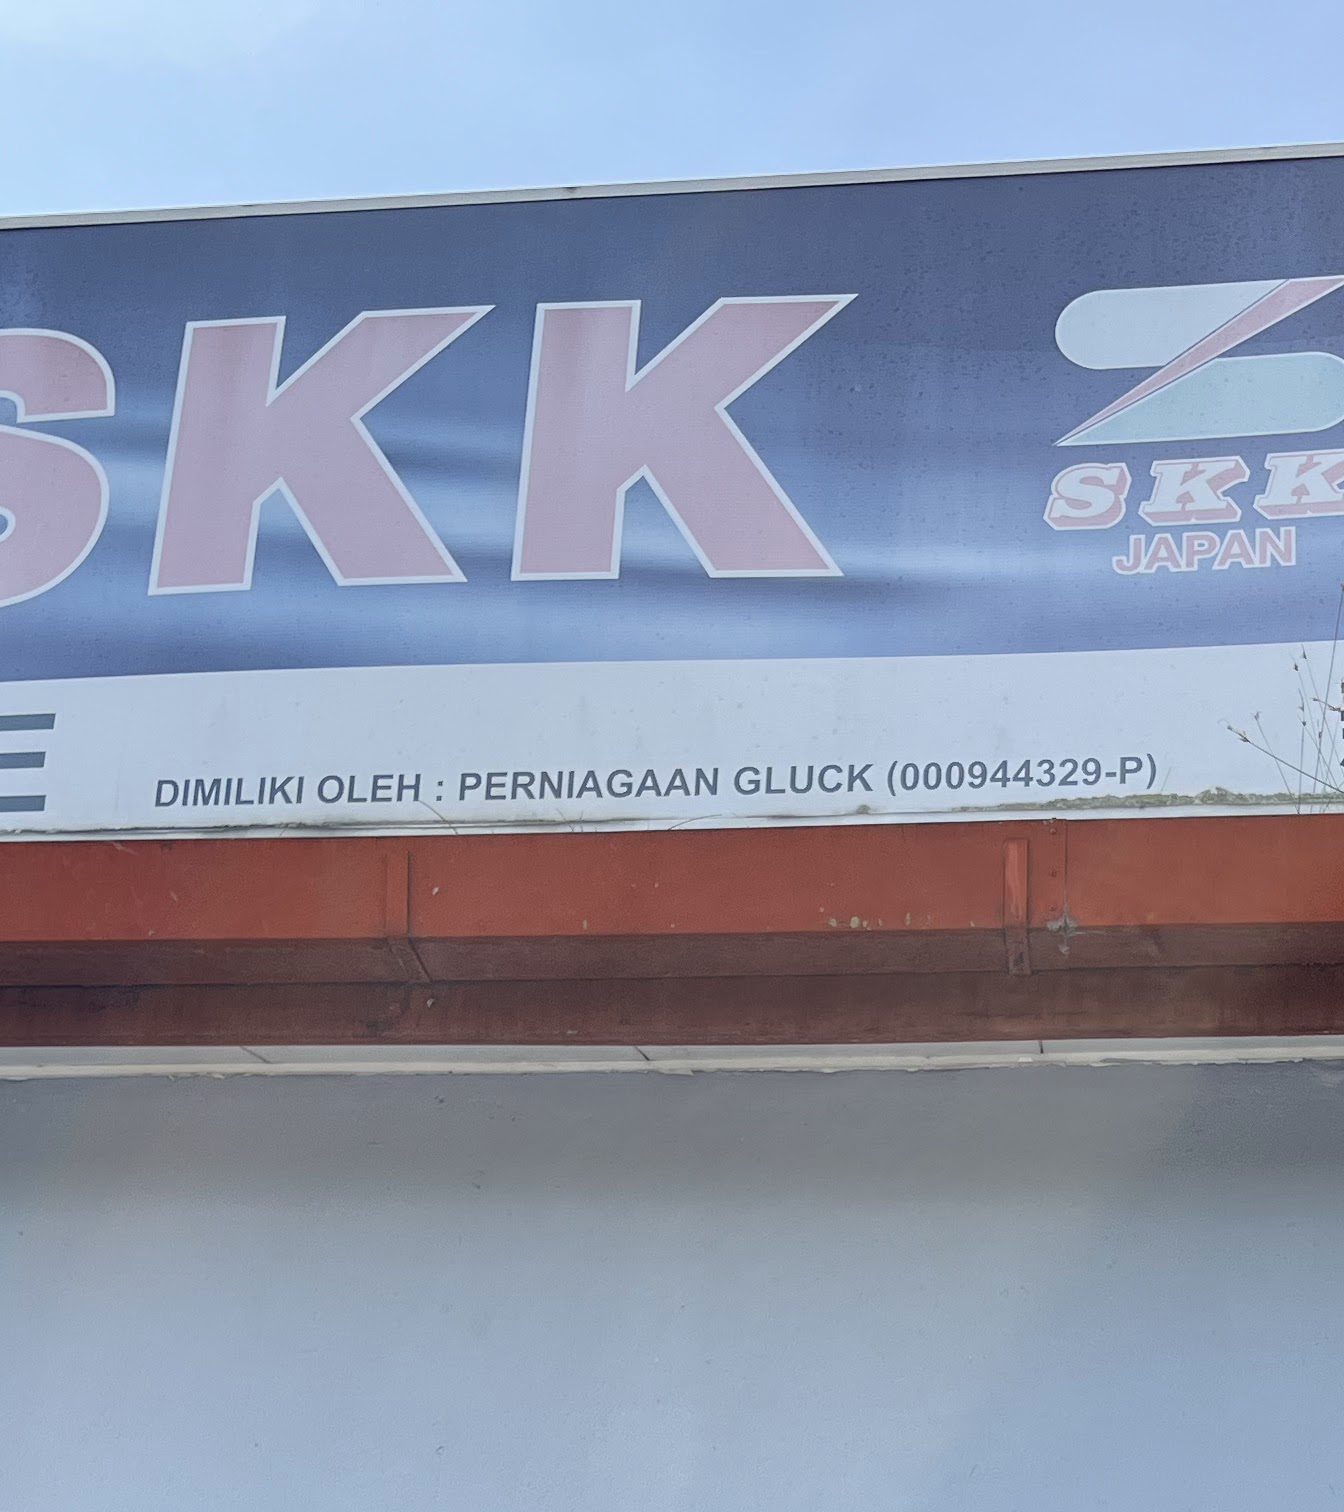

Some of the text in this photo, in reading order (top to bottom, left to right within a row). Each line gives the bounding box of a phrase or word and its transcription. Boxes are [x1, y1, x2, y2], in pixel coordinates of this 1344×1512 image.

[1112, 526, 1297, 576] JAPAN
[154, 775, 305, 807] DIMILIKI
[316, 772, 424, 803] OLEH
[456, 766, 720, 801] PERNIAGAAN
[732, 762, 874, 796] GLUCK
[885, 753, 1159, 797] (000944329-P)
